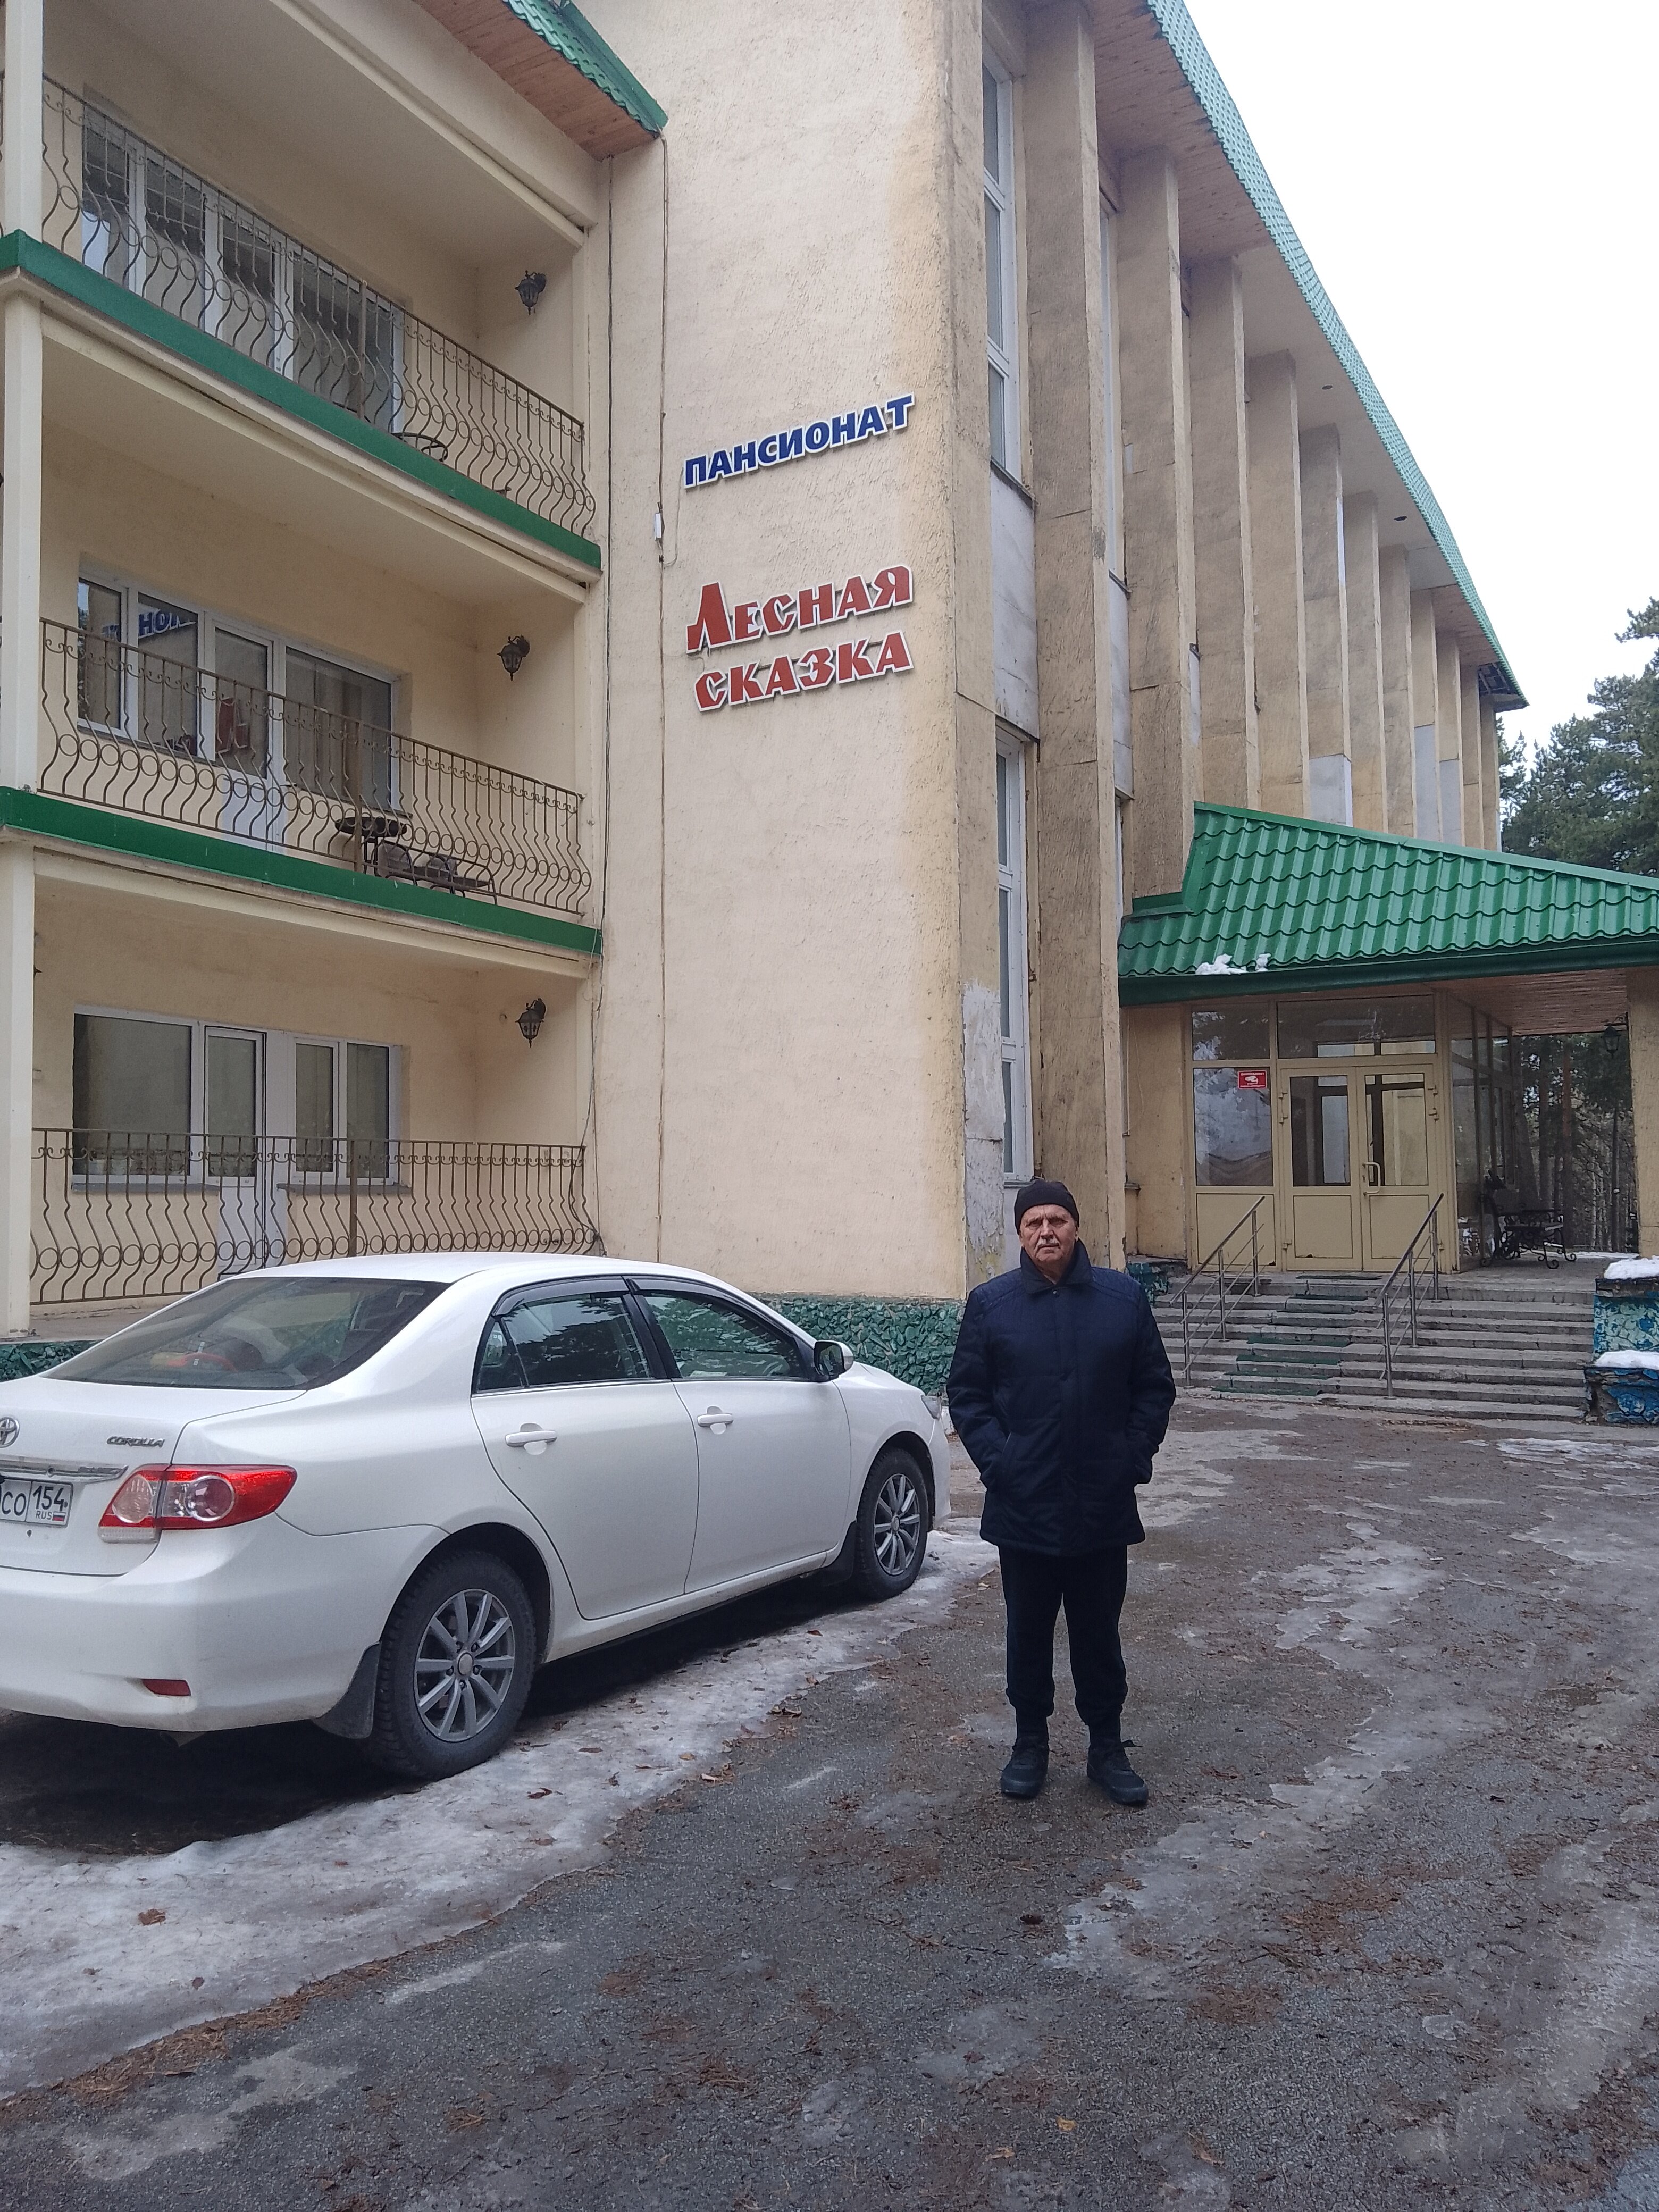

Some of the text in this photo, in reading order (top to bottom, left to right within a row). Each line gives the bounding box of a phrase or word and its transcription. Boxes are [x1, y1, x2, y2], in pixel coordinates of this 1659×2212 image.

[684, 392, 915, 489] ПАНСИОНАТ
[685, 565, 913, 654] ЛЕСНАЯ
[694, 631, 914, 711] СКАЗКА
[106, 1436, 165, 1448] COROLLA
[0, 1485, 64, 1516] СО 154
[35, 1510, 52, 1520] RUS
